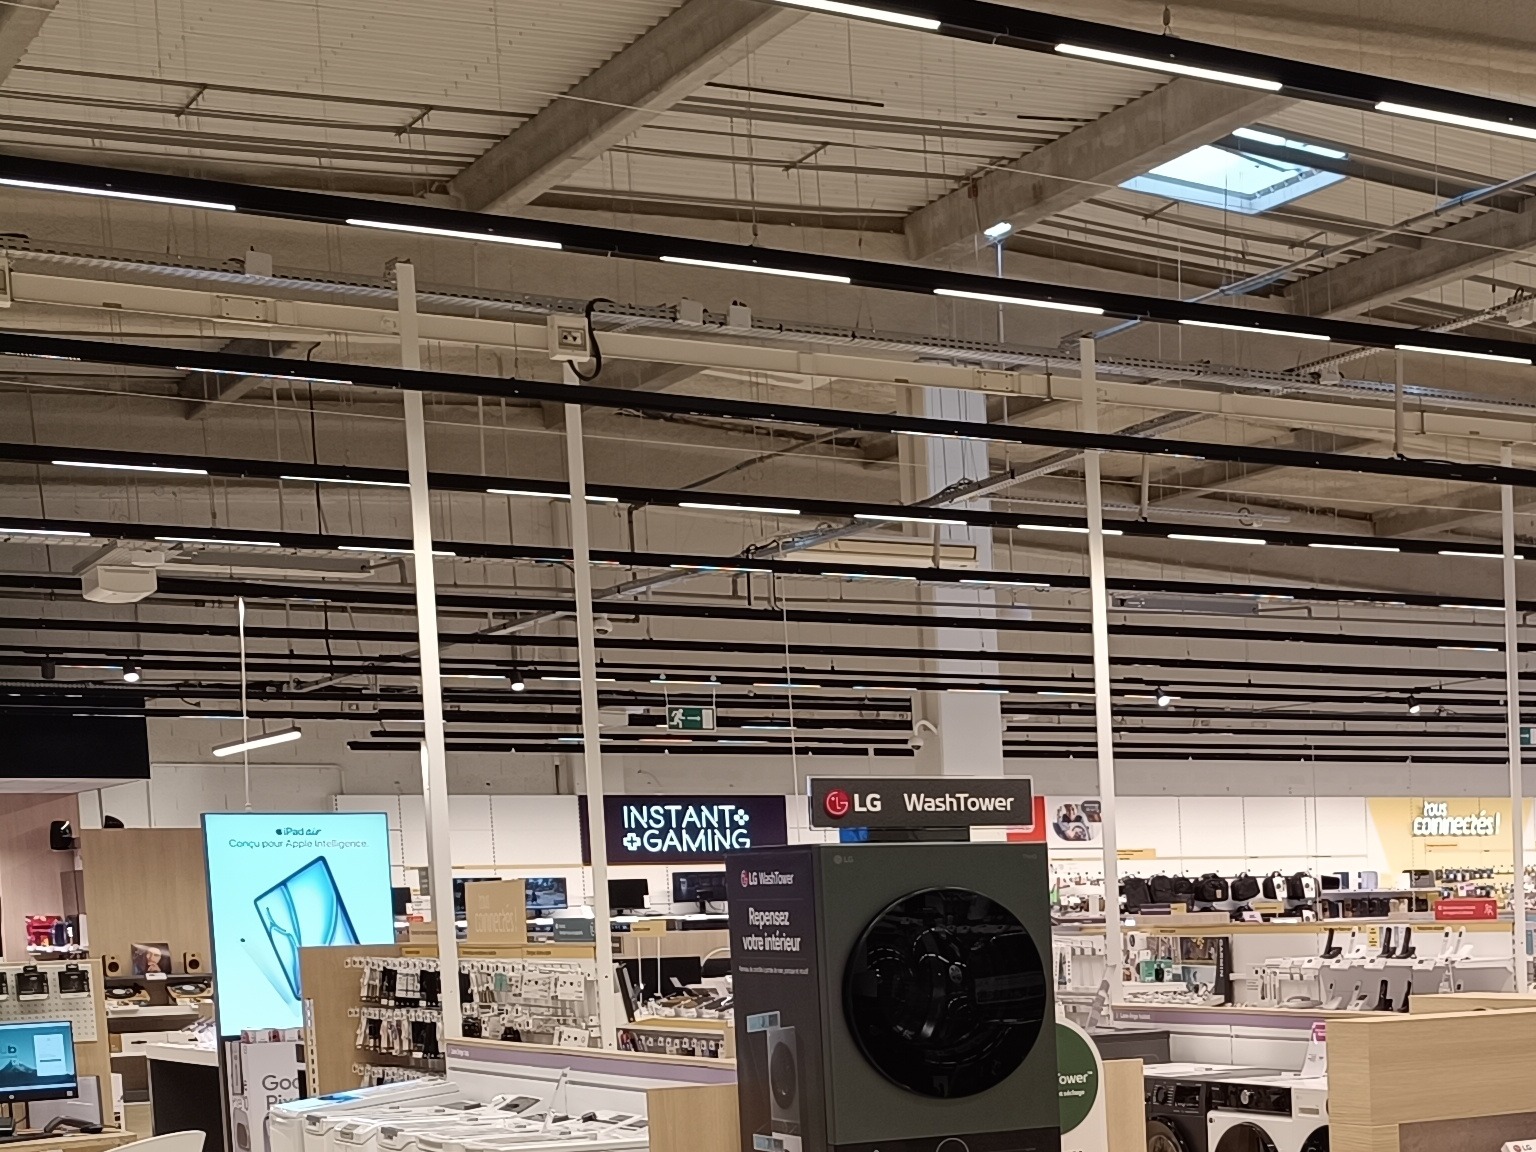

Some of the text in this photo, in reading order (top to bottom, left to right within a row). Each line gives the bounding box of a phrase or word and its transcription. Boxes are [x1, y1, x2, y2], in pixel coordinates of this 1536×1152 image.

[854, 793, 1014, 812] LG WashTower
[623, 805, 735, 828] INSTANT
[229, 839, 260, 849] Conçu
[262, 841, 283, 849] pour
[286, 839, 312, 848] Apple
[643, 829, 750, 852] GAMING
[748, 871, 795, 885] LG WashTower
[748, 907, 790, 929] Repensez
[742, 930, 801, 952] votre intérieur
